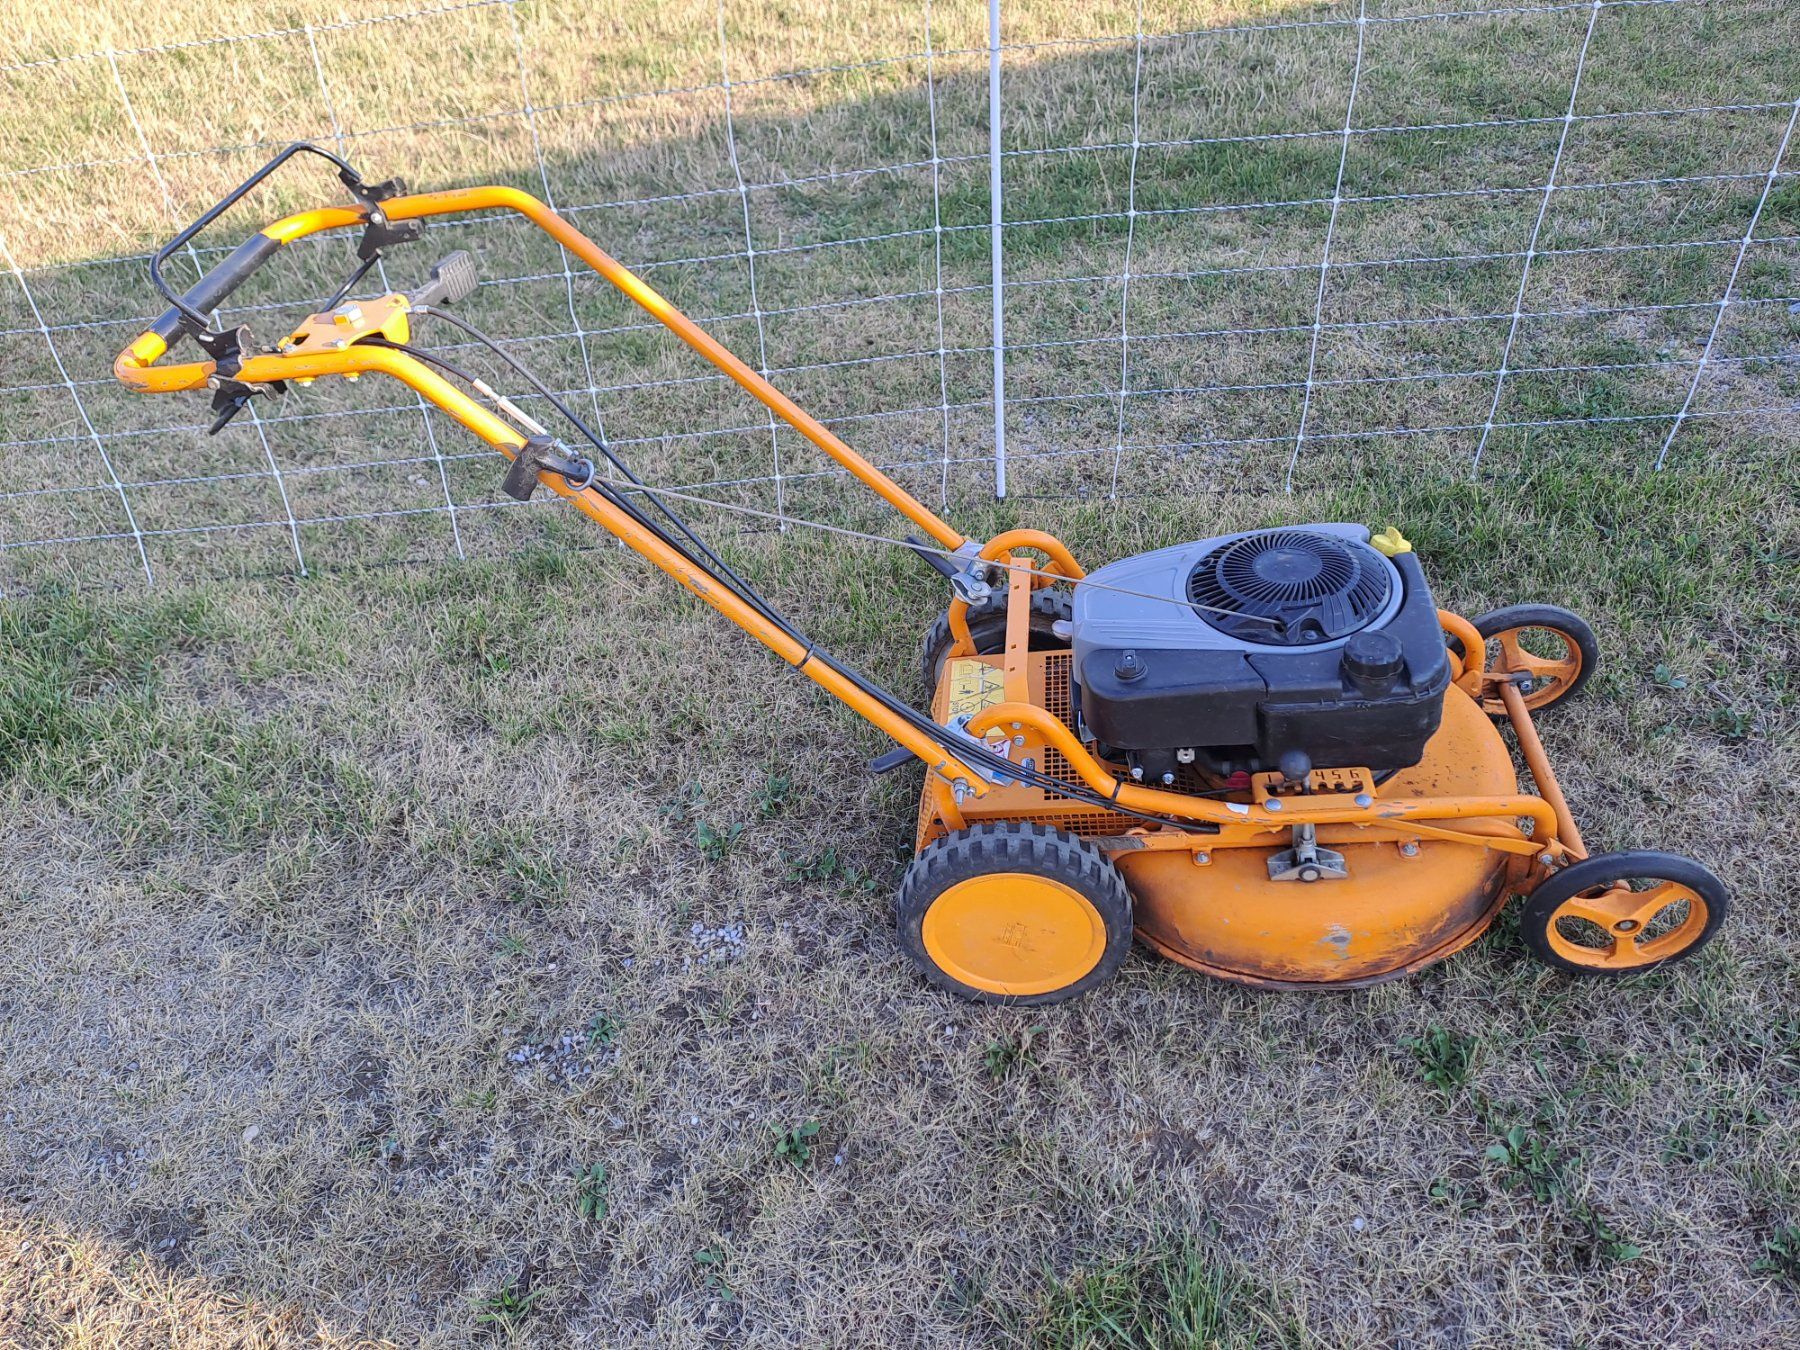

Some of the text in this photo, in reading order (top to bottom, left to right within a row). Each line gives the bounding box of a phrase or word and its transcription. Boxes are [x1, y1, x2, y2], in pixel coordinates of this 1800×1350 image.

[1315, 770, 1325, 780] 4
[1331, 769, 1341, 779] 5
[1349, 769, 1360, 779] 6
